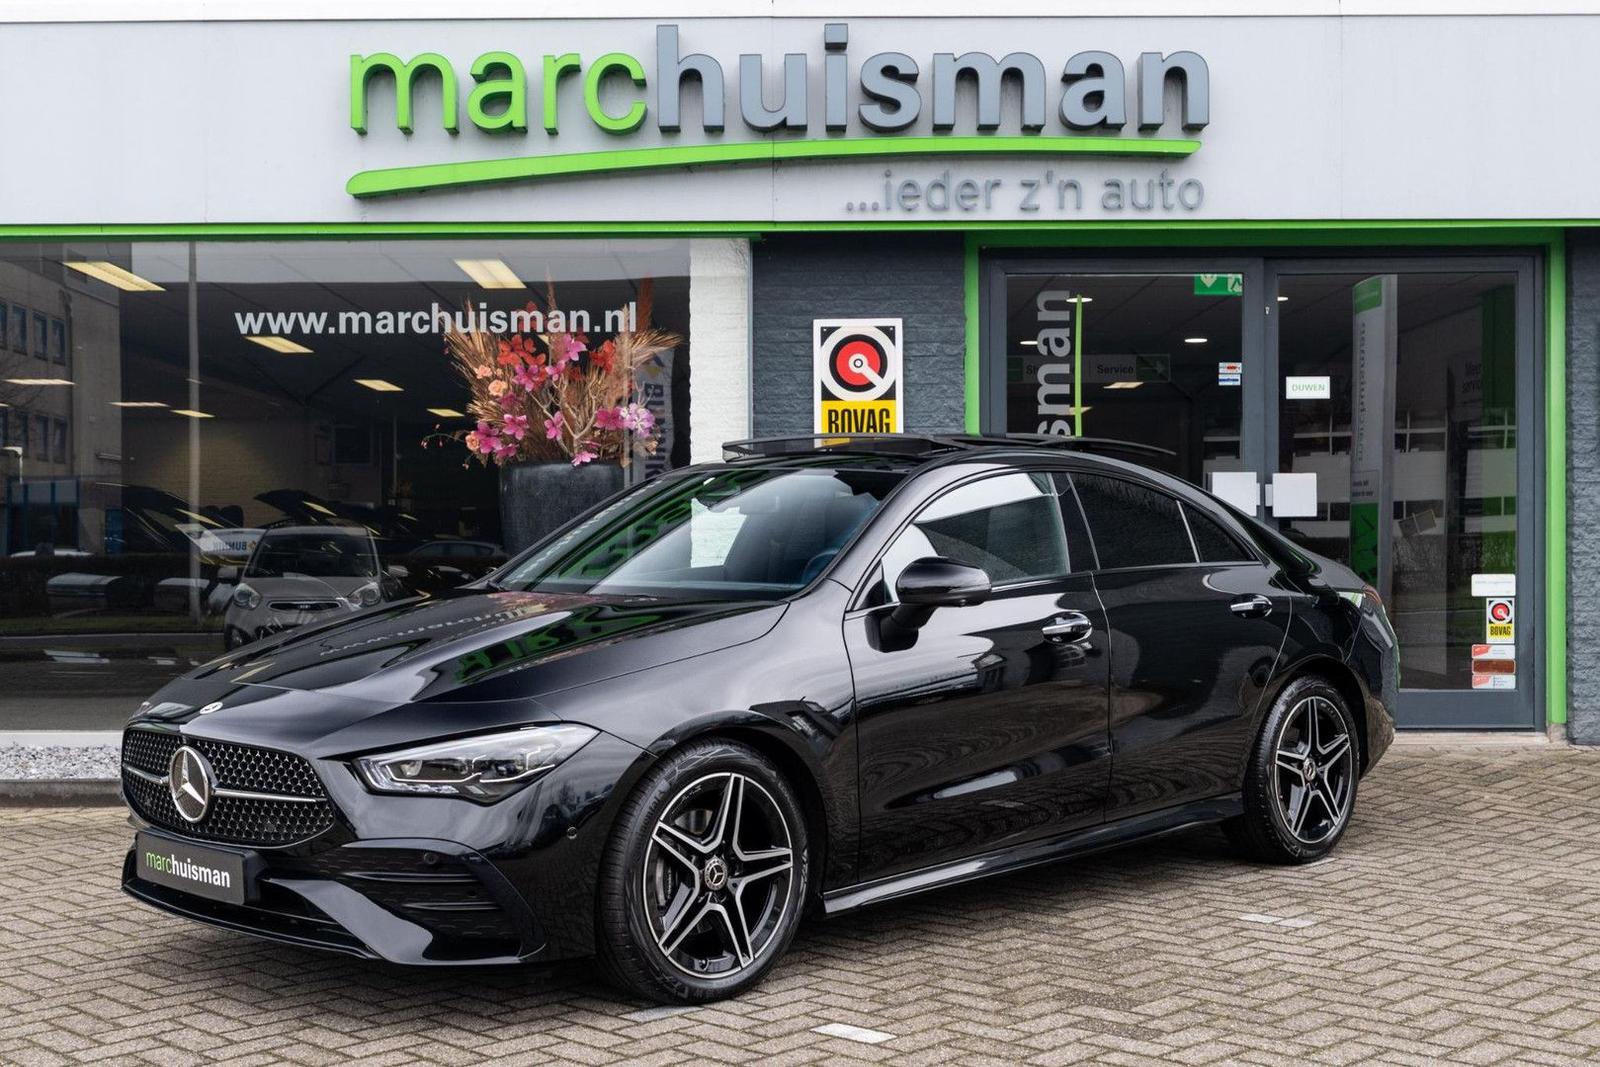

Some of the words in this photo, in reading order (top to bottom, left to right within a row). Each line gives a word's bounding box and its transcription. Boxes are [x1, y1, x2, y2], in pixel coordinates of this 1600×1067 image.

[349, 23, 1210, 136] marchuisman
[1019, 169, 1082, 212] z'n
[1101, 168, 1205, 212] auto
[235, 302, 637, 335] www.marchuisman.nl
[1096, 364, 1134, 375] Service
[1291, 383, 1326, 392] DUWEN
[828, 408, 891, 433] BOVAG
[1490, 625, 1511, 636] BOVAG
[146, 851, 231, 888] marchuisman
